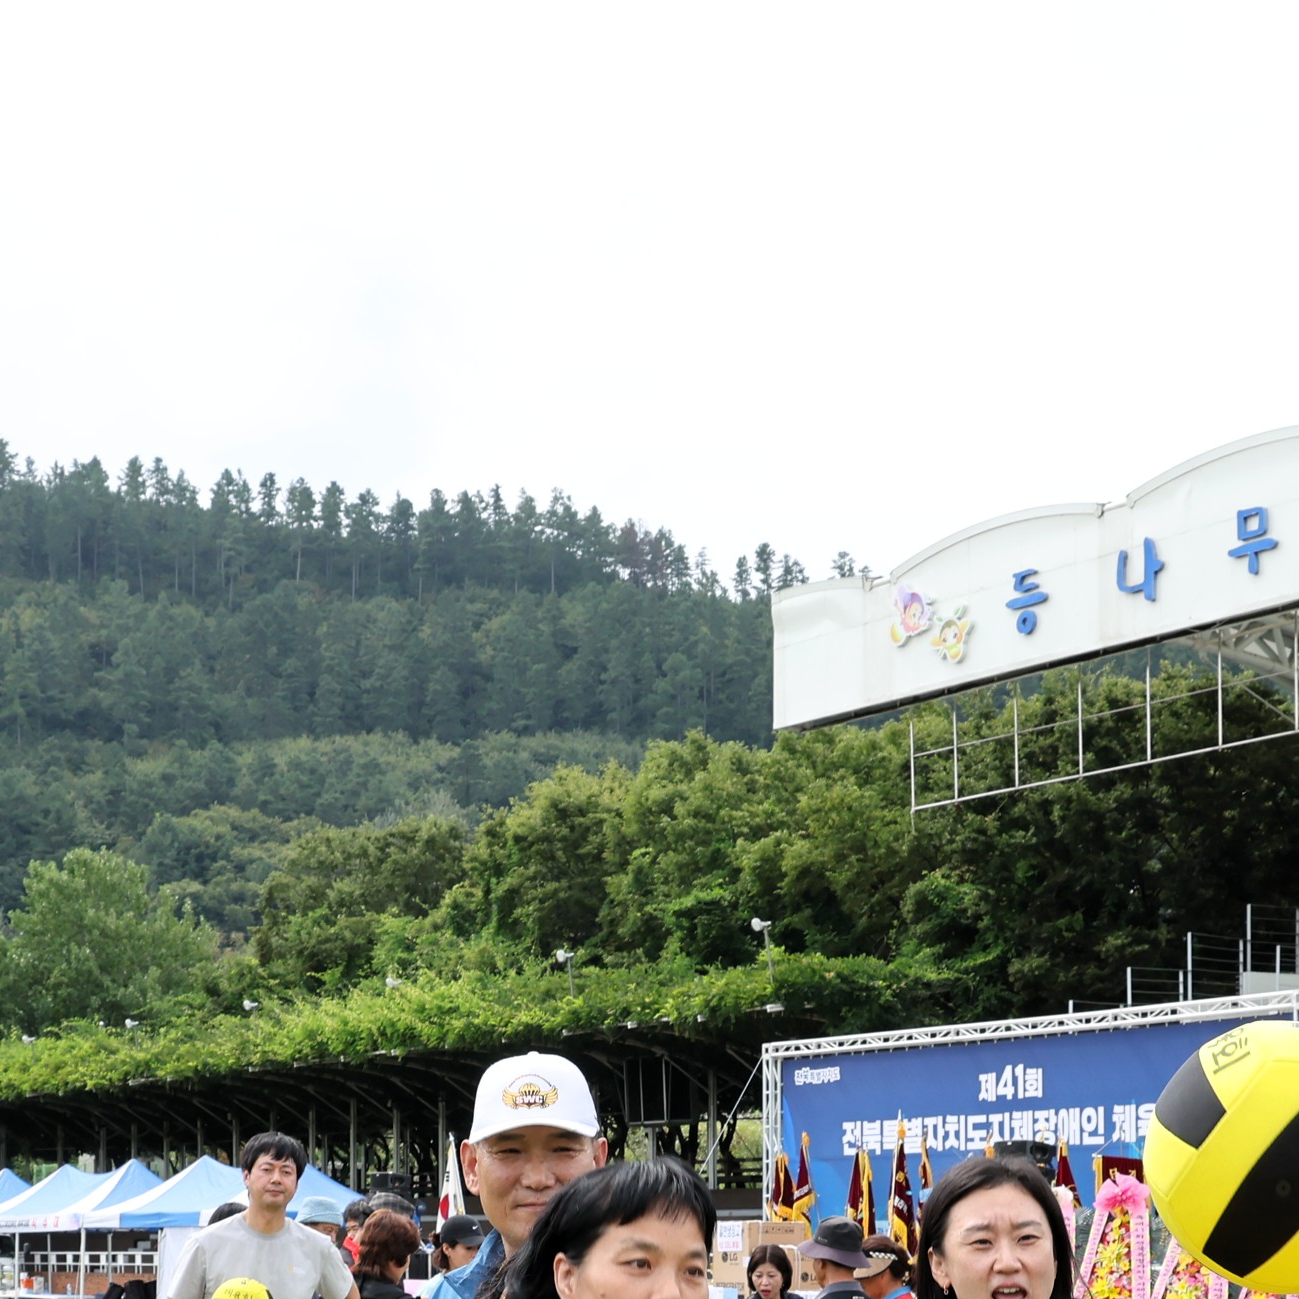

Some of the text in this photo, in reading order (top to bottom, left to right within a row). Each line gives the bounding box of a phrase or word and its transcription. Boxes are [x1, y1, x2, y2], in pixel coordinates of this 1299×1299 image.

[794, 1066, 841, 1085] 전북특별자치도
[978, 1063, 1044, 1102] 제41회
[515, 1095, 544, 1104] SWC
